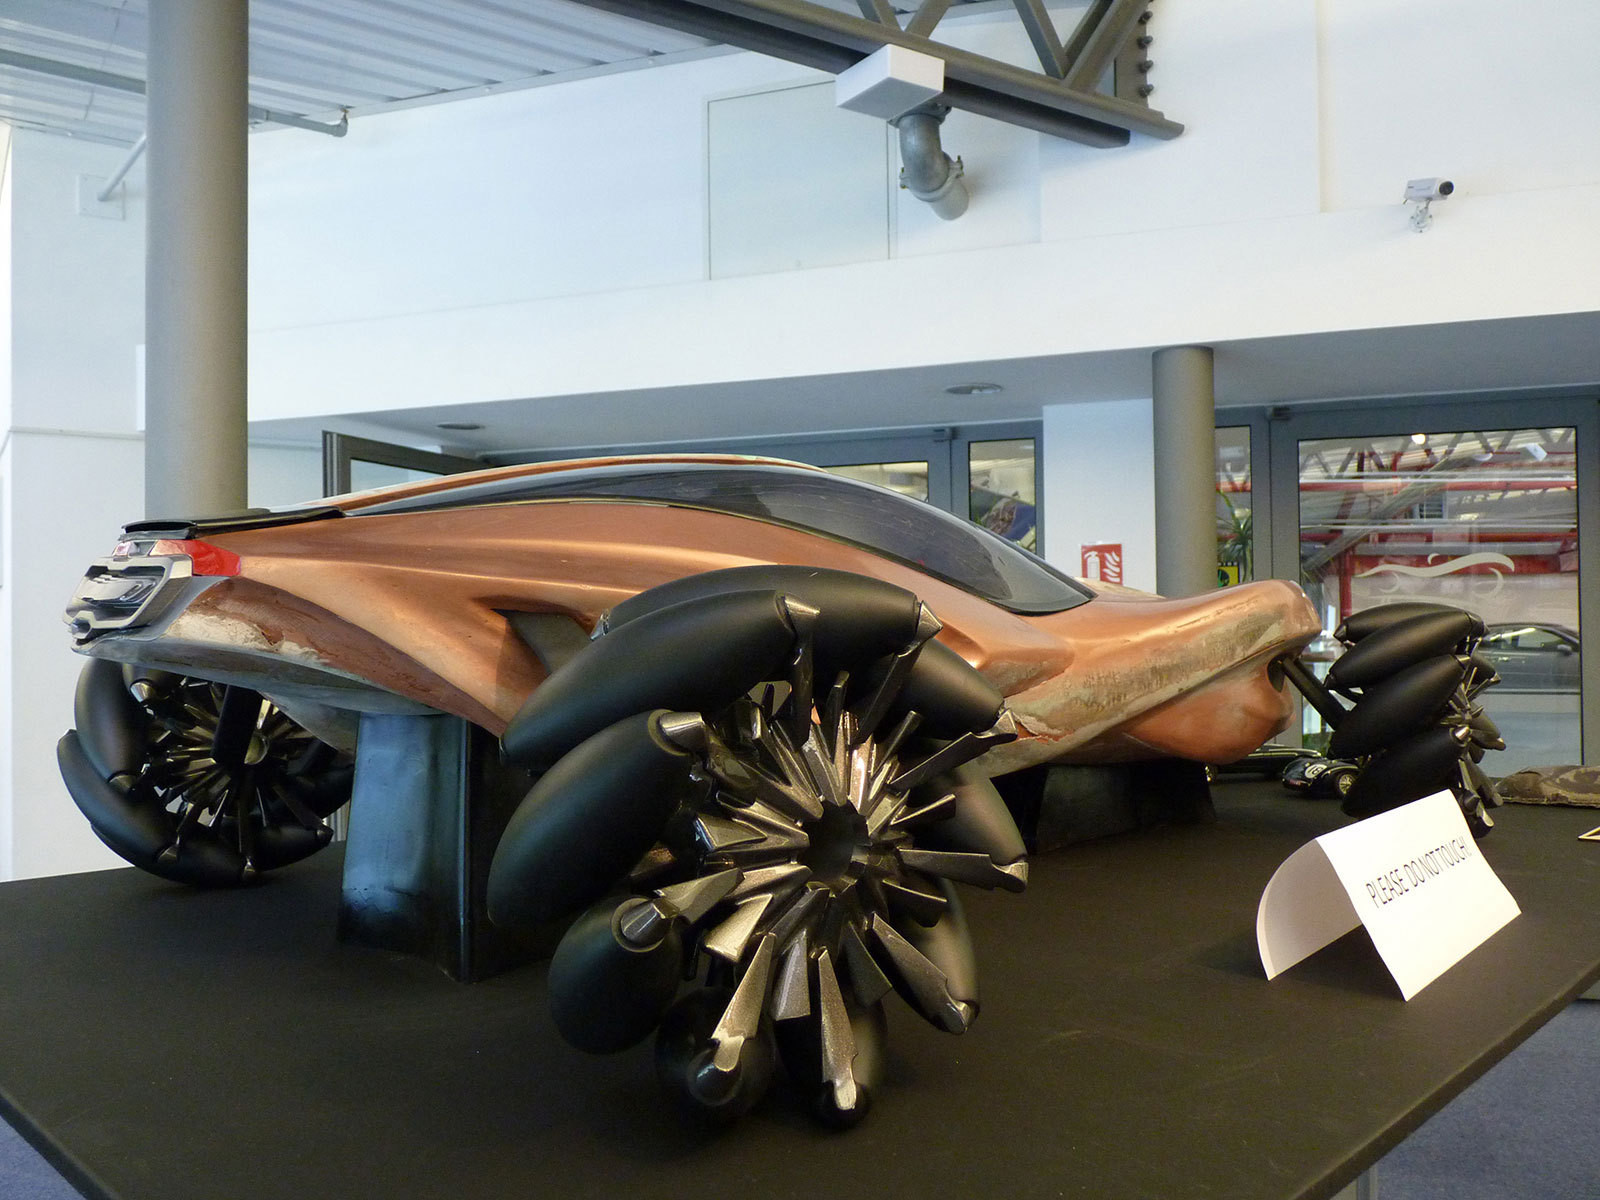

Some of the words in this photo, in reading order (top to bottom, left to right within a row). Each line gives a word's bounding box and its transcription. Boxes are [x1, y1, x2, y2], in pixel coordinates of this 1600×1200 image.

[1366, 868, 1409, 909] PLEASE
[1403, 860, 1425, 887] DO
[1417, 850, 1443, 879] NOT
[1435, 836, 1472, 869] TOUCH!
